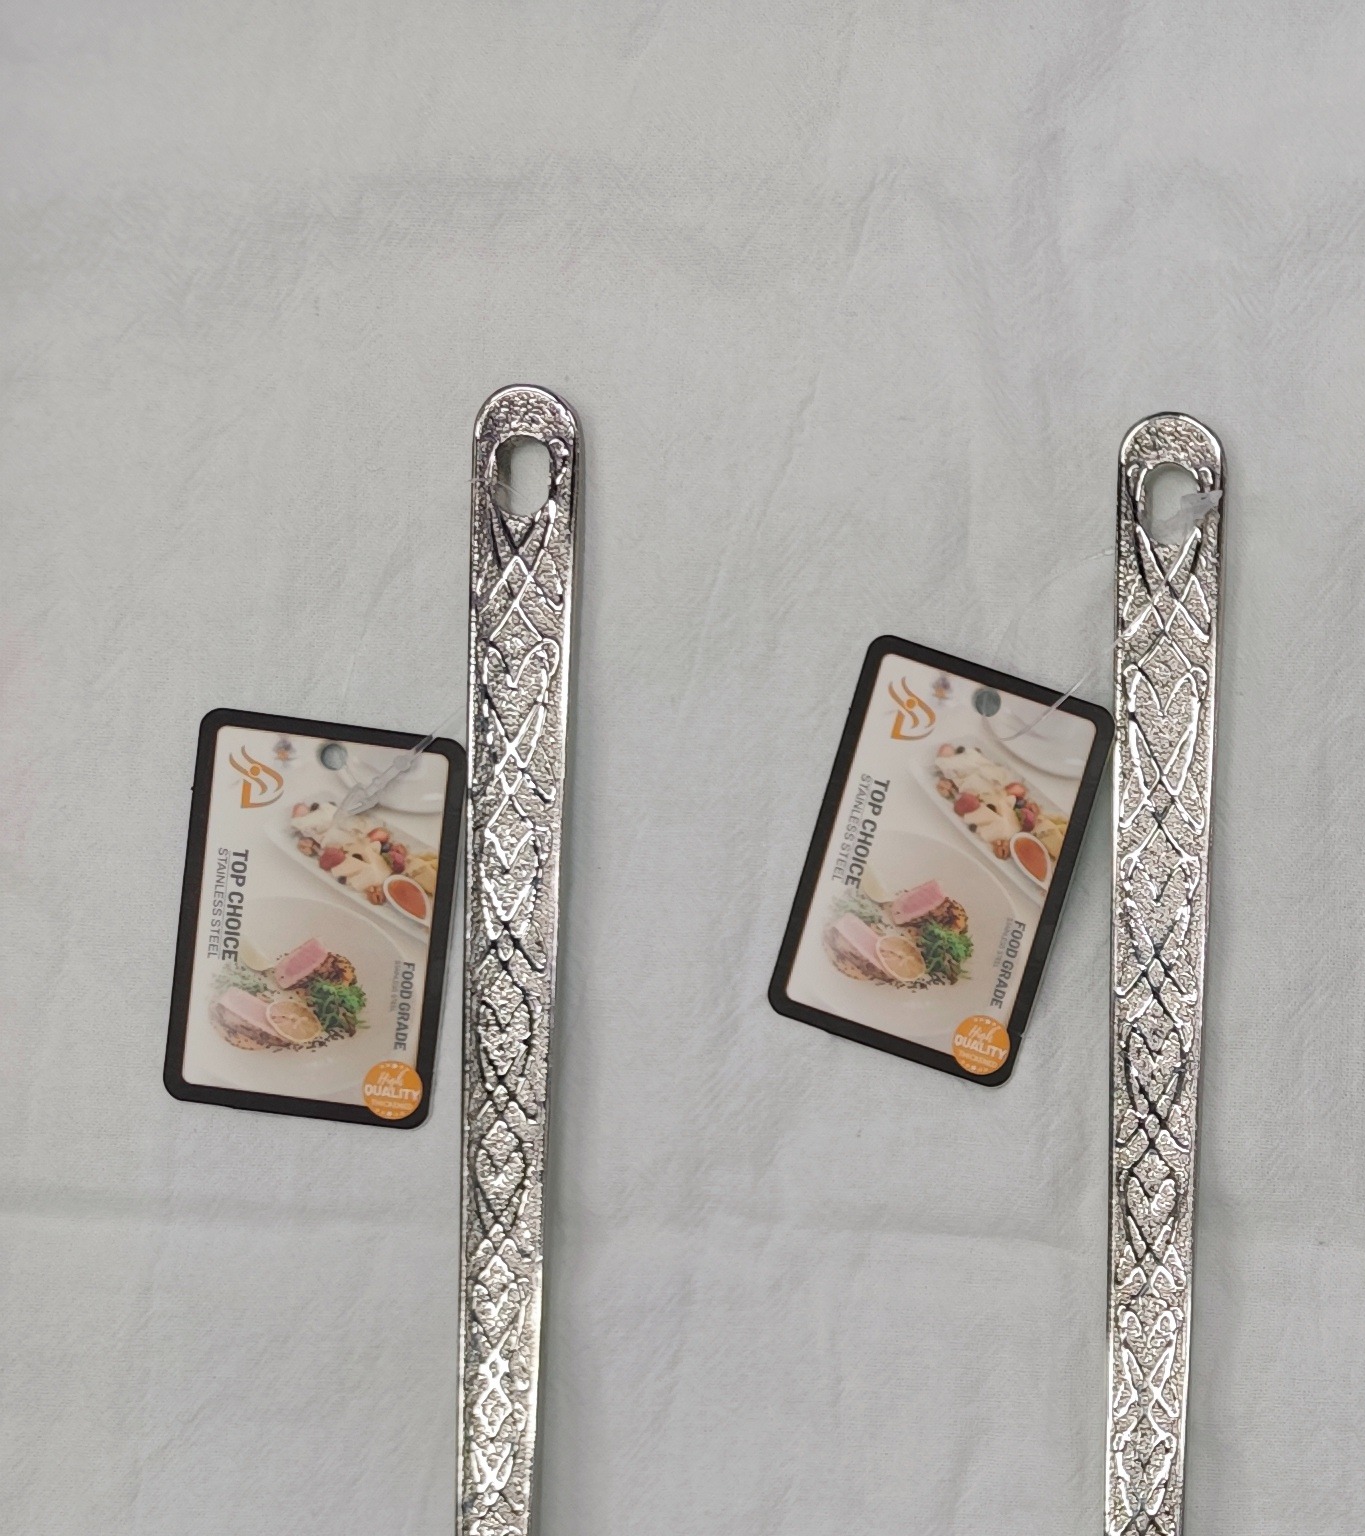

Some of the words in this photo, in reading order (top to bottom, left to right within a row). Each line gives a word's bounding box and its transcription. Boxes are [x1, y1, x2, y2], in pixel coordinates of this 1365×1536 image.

[843, 772, 871, 841] STAINLESS
[867, 779, 890, 816] TOP
[230, 849, 249, 887] TOP
[830, 842, 850, 881] STEEL
[843, 818, 877, 889] CHOICE
[211, 846, 228, 916] STAINLESS
[206, 918, 220, 959] STEEL
[221, 891, 244, 962] CHOICE
[1005, 919, 1026, 958] FOOD
[399, 961, 415, 999] FOOD
[989, 960, 1013, 1009] GRADE
[393, 1002, 410, 1051] GRADE
[954, 1034, 1007, 1060] QUALITY
[364, 1083, 420, 1101] QUALITY
